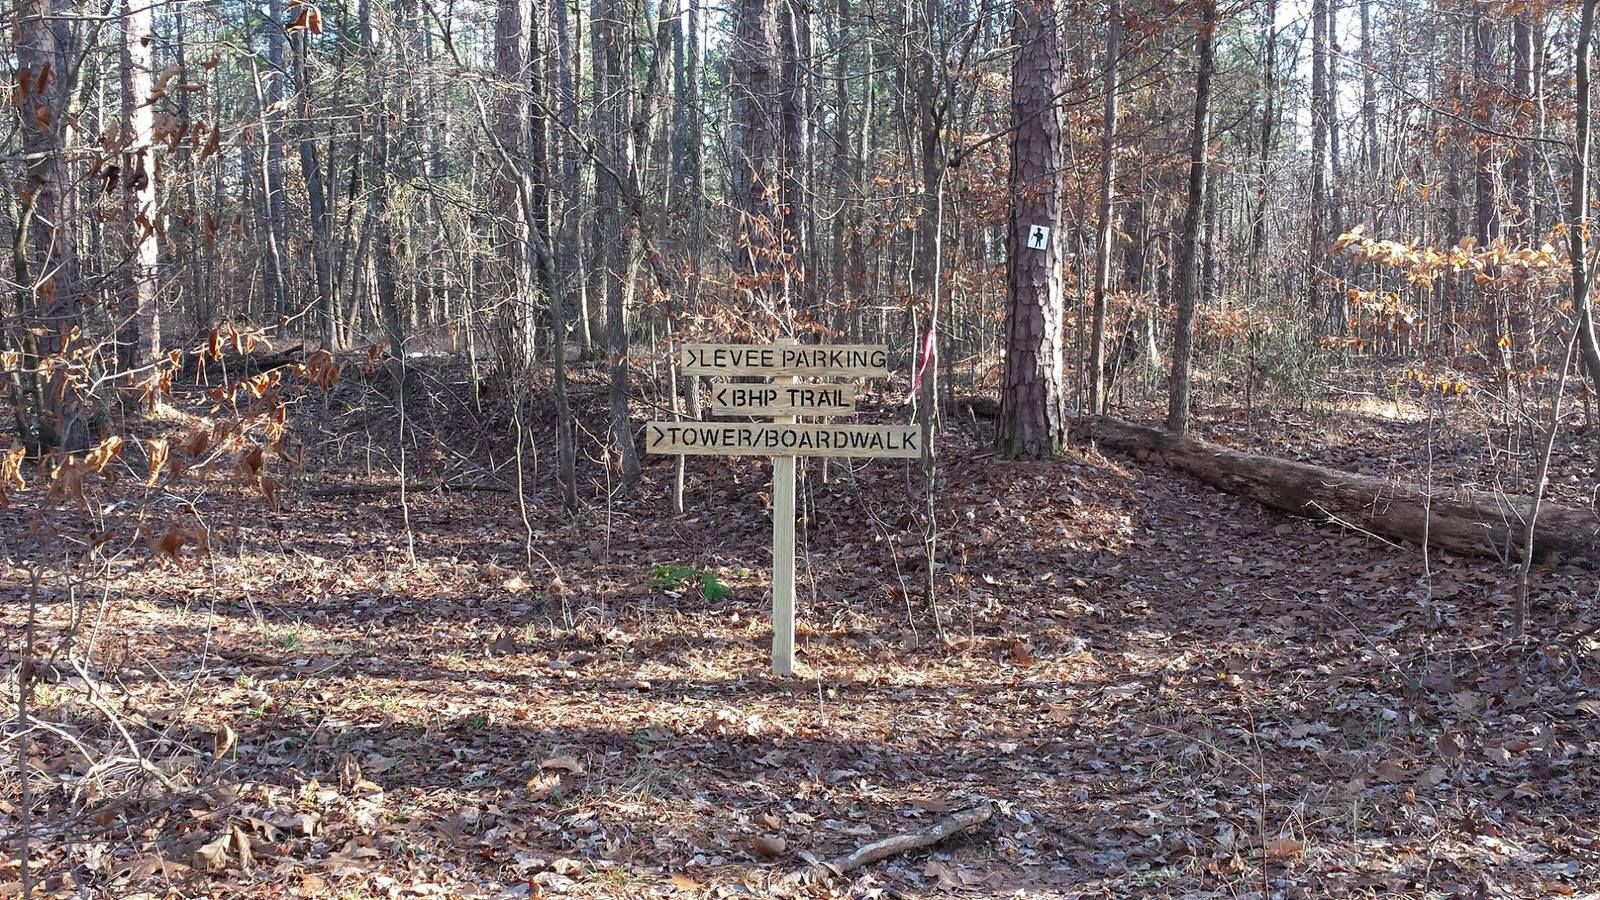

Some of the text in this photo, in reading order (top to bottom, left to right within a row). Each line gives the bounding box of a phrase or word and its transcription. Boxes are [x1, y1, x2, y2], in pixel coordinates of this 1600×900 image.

[699, 349, 887, 368] LEVEE PARKING
[732, 389, 850, 407] BHP TRAIL
[667, 427, 917, 450] TOWER/BOARDWALK
